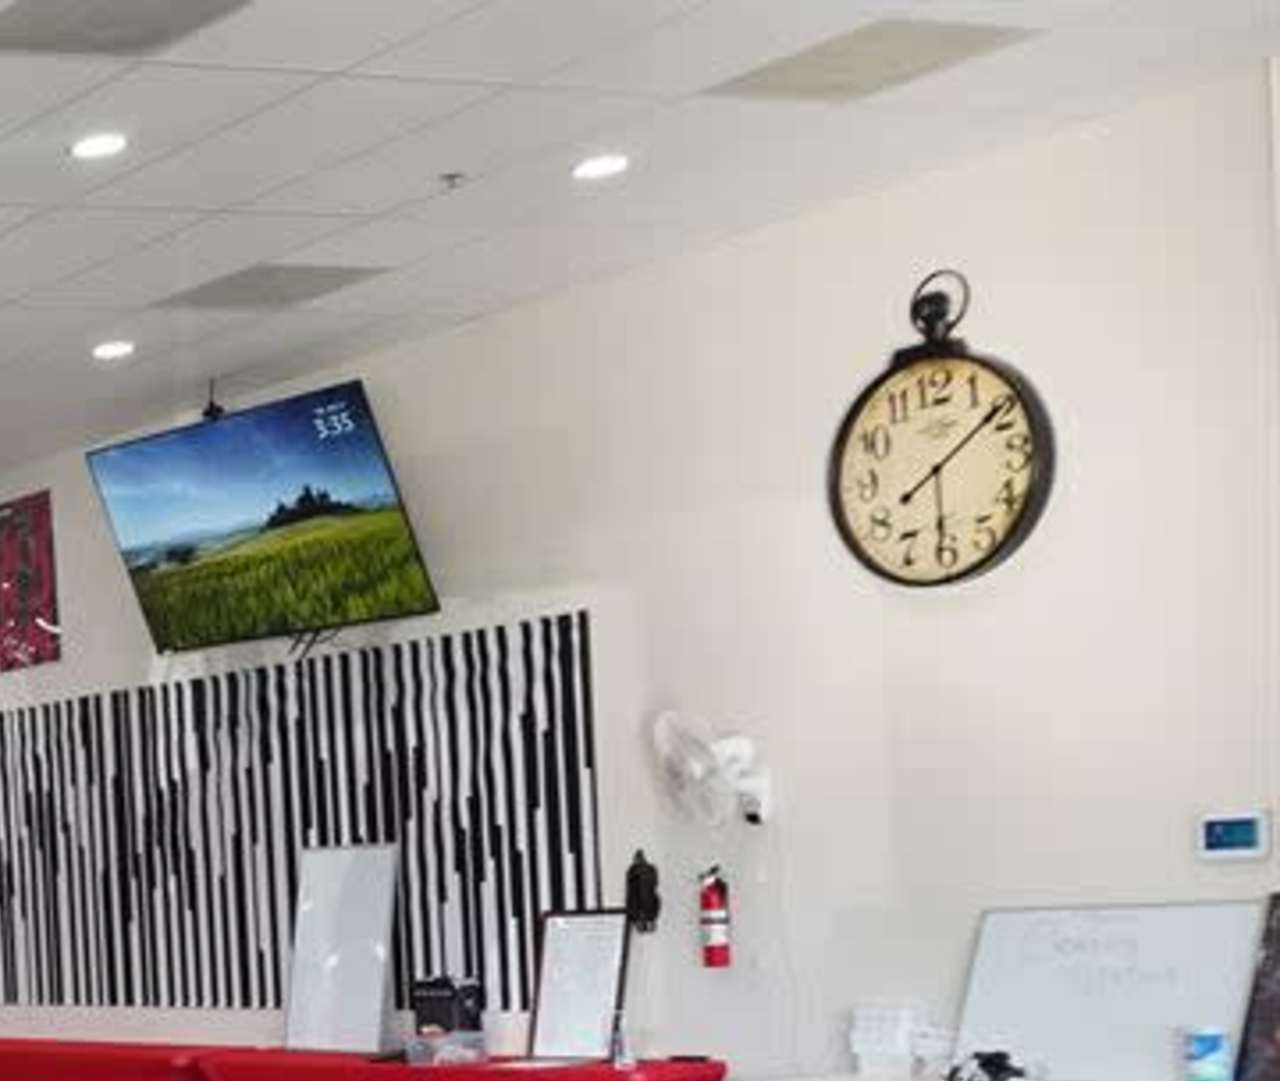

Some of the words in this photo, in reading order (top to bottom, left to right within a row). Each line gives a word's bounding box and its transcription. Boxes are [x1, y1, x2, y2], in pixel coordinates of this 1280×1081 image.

[889, 388, 910, 424] 11
[915, 367, 954, 410] 12
[966, 373, 980, 409] 1
[992, 394, 1018, 431] 2
[861, 426, 890, 459] 10
[1005, 433, 1032, 473] 3
[857, 468, 879, 503] 9
[996, 479, 1023, 513] 4
[869, 507, 892, 542] 8
[972, 513, 998, 551] 5
[898, 530, 920, 566] 7
[934, 534, 959, 569] 6
